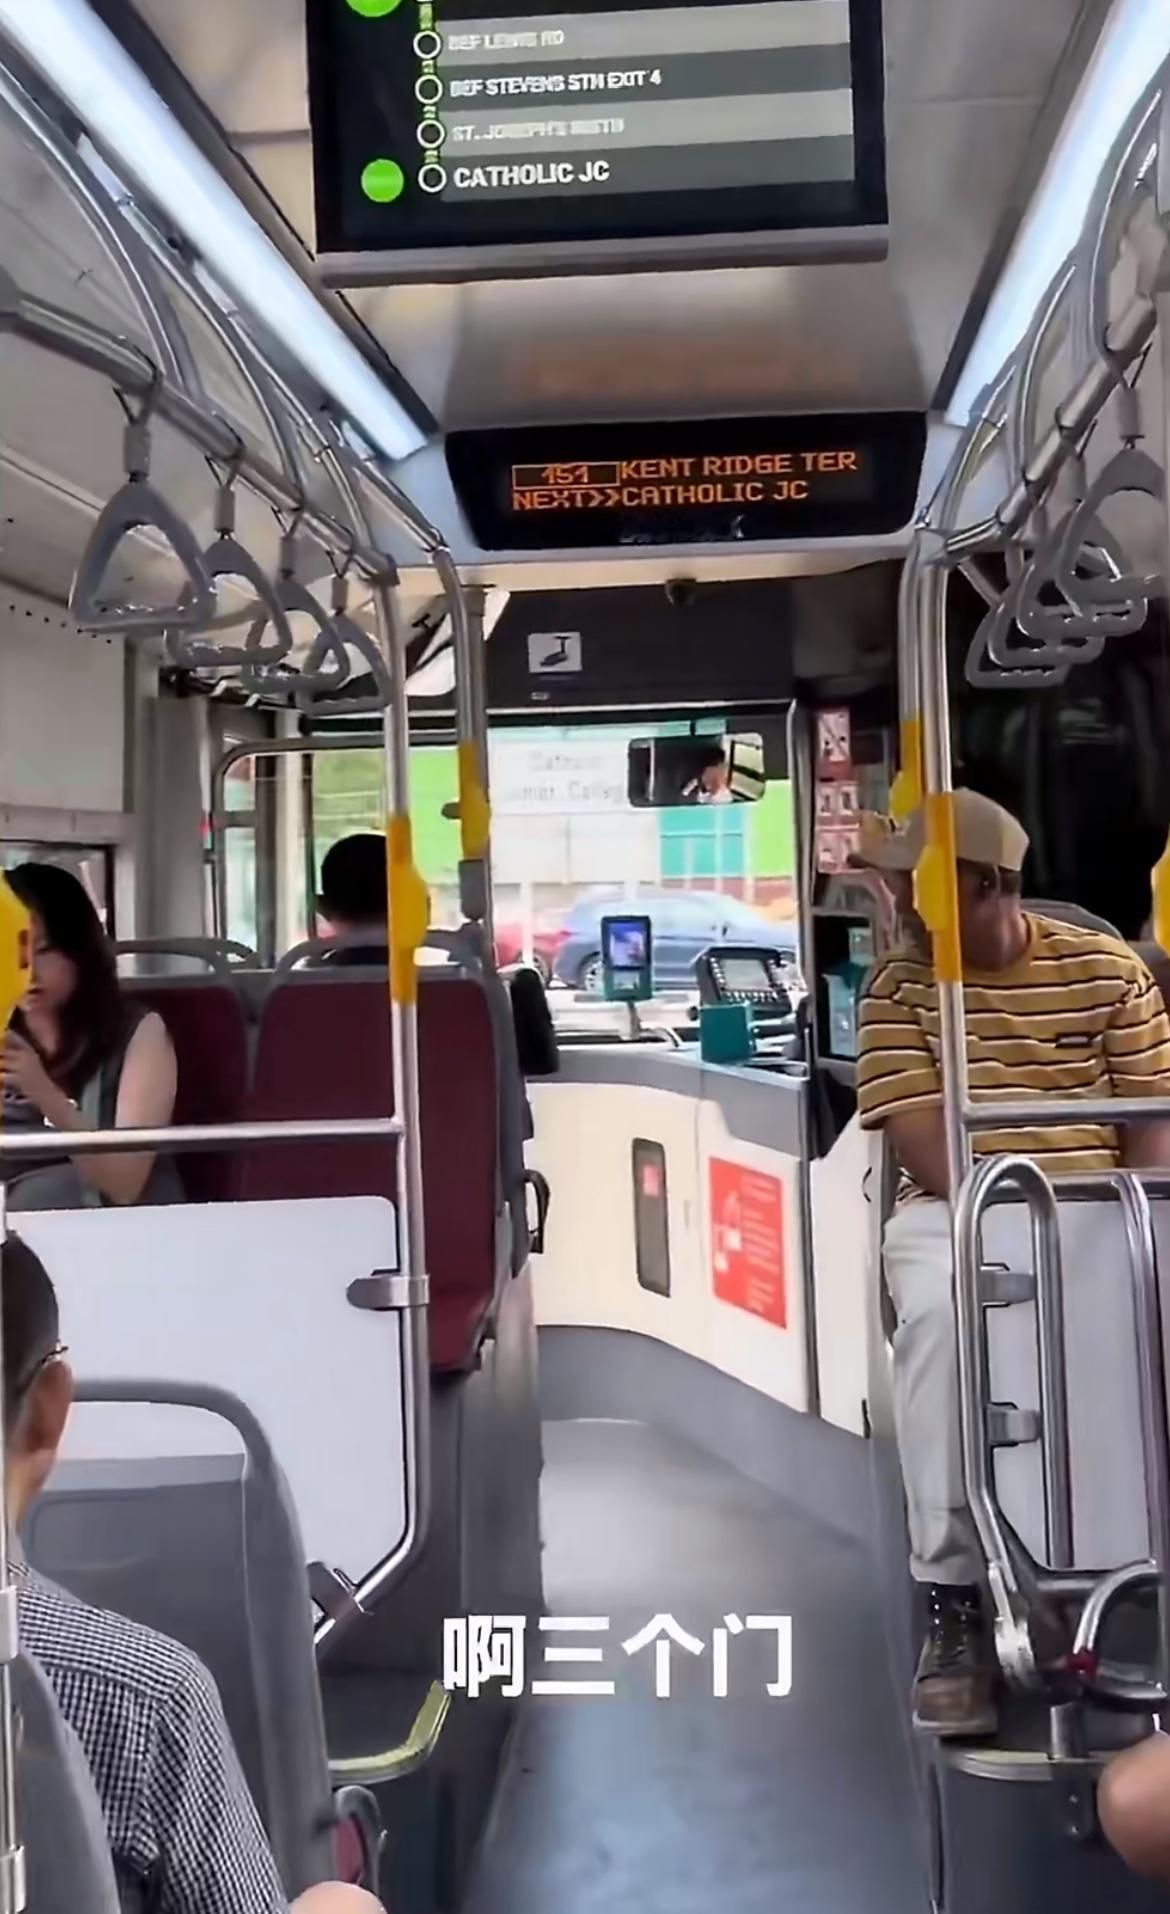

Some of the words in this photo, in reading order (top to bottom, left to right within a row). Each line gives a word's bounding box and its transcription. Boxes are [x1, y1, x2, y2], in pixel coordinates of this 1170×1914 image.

[649, 68, 662, 85] 4
[453, 163, 575, 189] CATHOLIC
[577, 160, 611, 183] JC
[541, 465, 590, 484] 151
[621, 457, 695, 479] KENT
[702, 454, 794, 476] RIDGE
[800, 451, 858, 473] TER
[773, 480, 809, 501] JC
